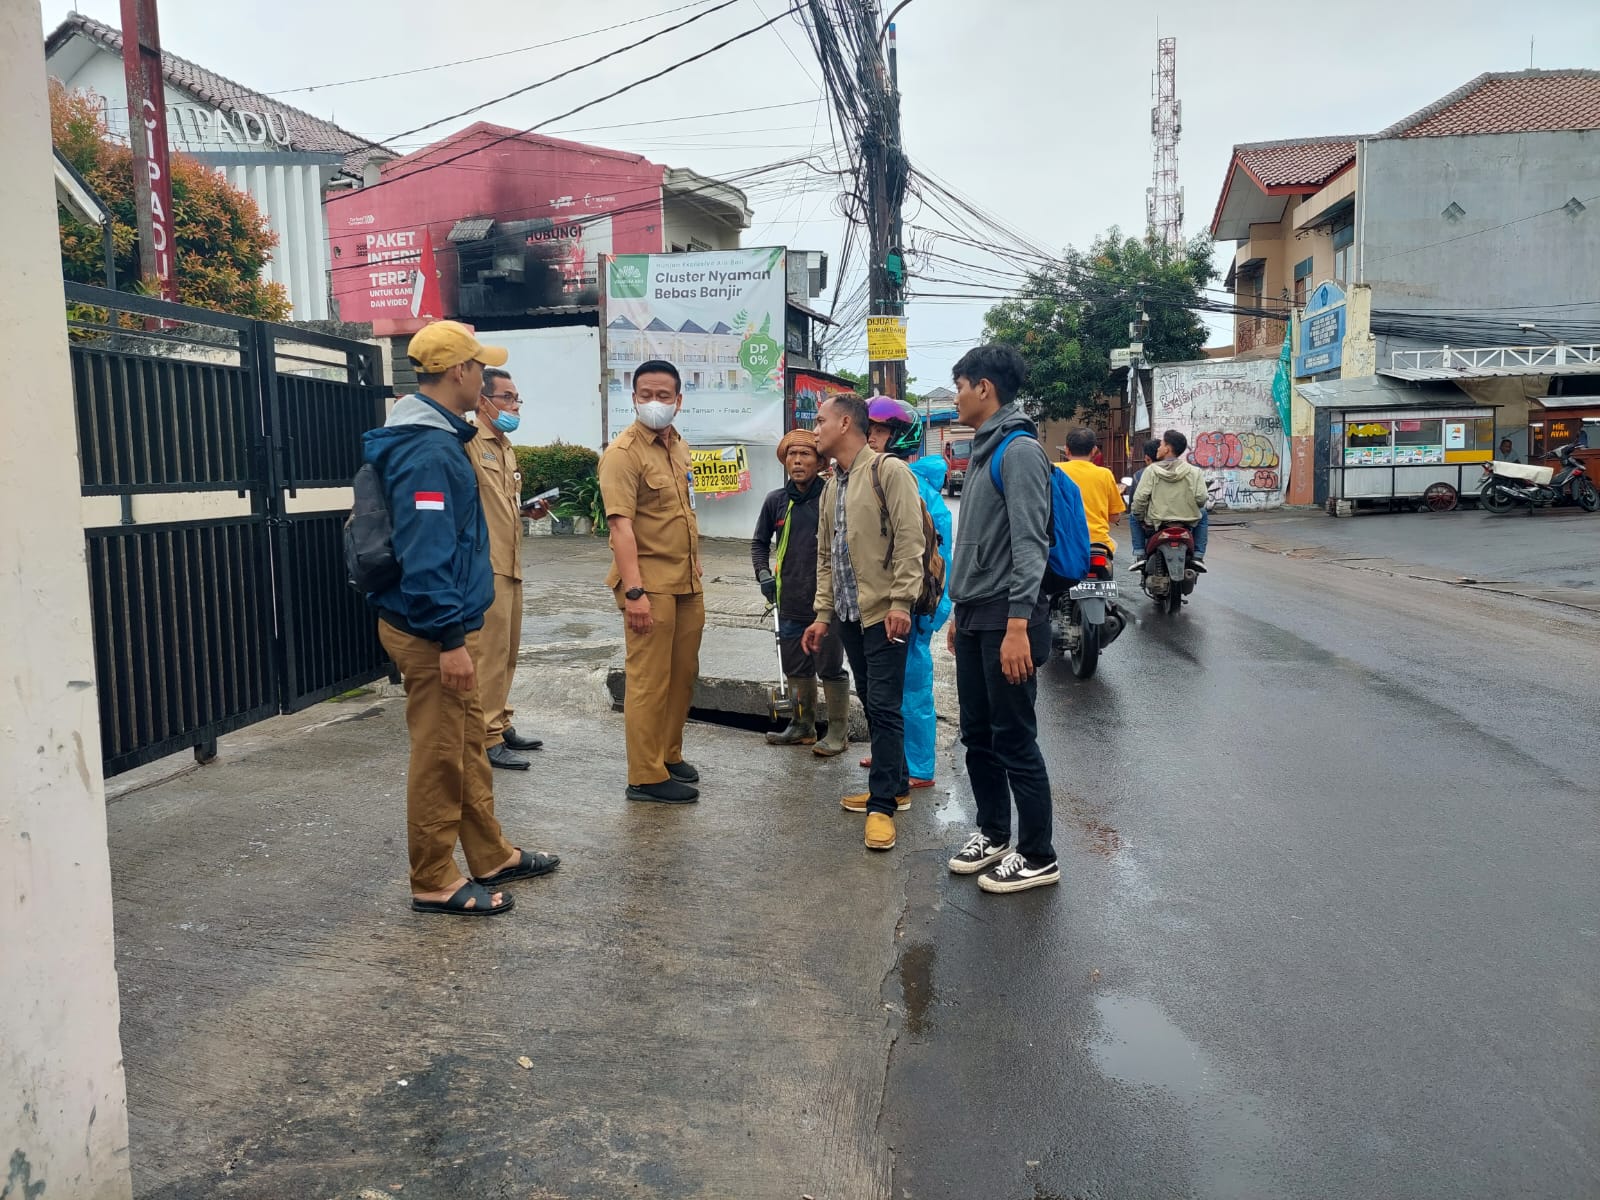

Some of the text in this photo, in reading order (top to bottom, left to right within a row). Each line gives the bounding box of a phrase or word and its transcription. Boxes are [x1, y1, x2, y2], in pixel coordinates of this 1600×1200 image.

[166, 104, 291, 145] IPADU
[366, 231, 416, 249] PAKET
[655, 270, 705, 284] Cluster
[708, 268, 771, 285] Nyaman
[369, 288, 393, 297] UNTUK
[655, 284, 743, 301] Bebas Banjir
[370, 298, 408, 308] DAN VIDEO
[867, 318, 895, 326] DIJUAL
[750, 344, 768, 354] DP
[750, 355, 768, 366] 0%
[1551, 430, 1569, 438] AYAM
[693, 462, 737, 475] ahlan
[701, 475, 719, 487] 8722
[720, 474, 738, 486] 9800
